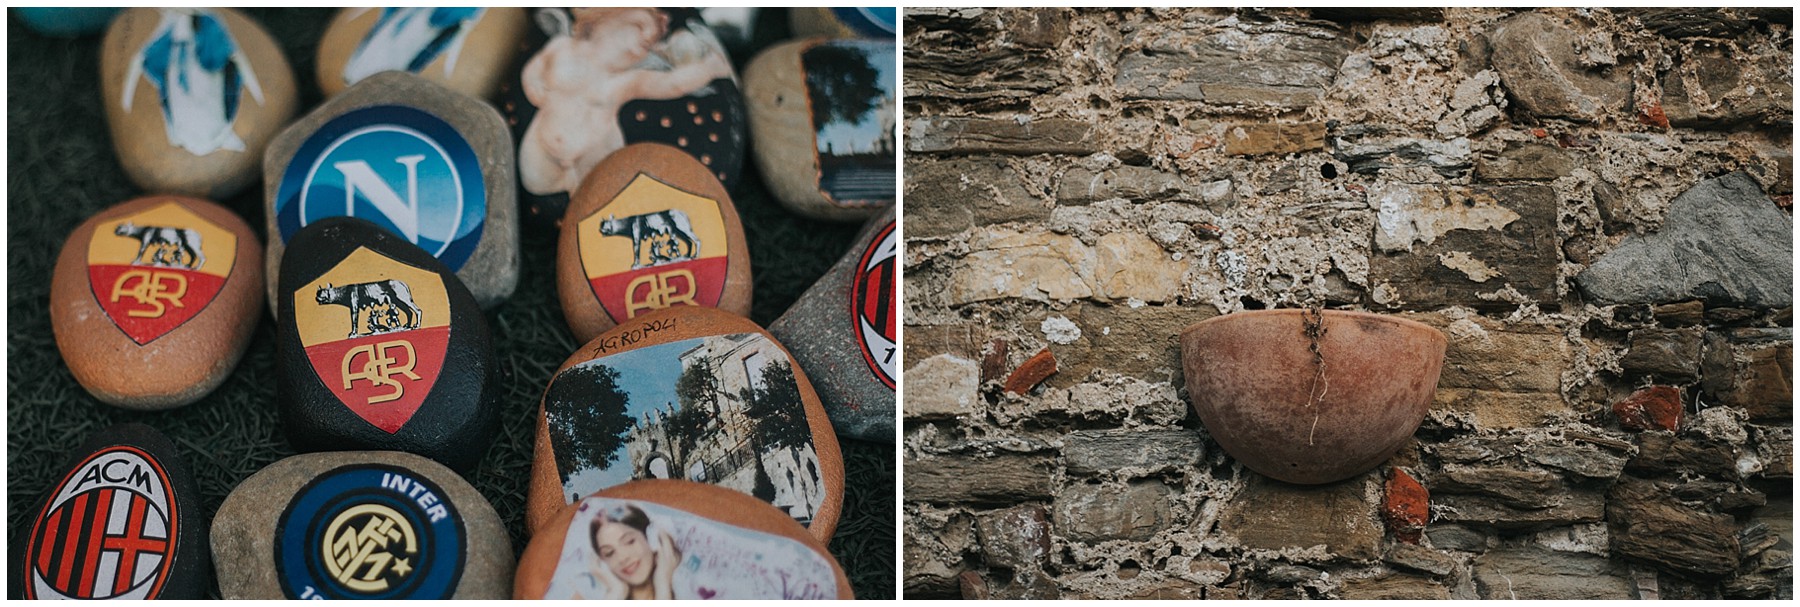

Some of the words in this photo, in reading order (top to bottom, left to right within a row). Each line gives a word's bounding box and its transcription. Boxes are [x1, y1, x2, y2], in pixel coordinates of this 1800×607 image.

[333, 154, 426, 245] N
[70, 459, 153, 494] ACM
[381, 472, 448, 524] INTER
